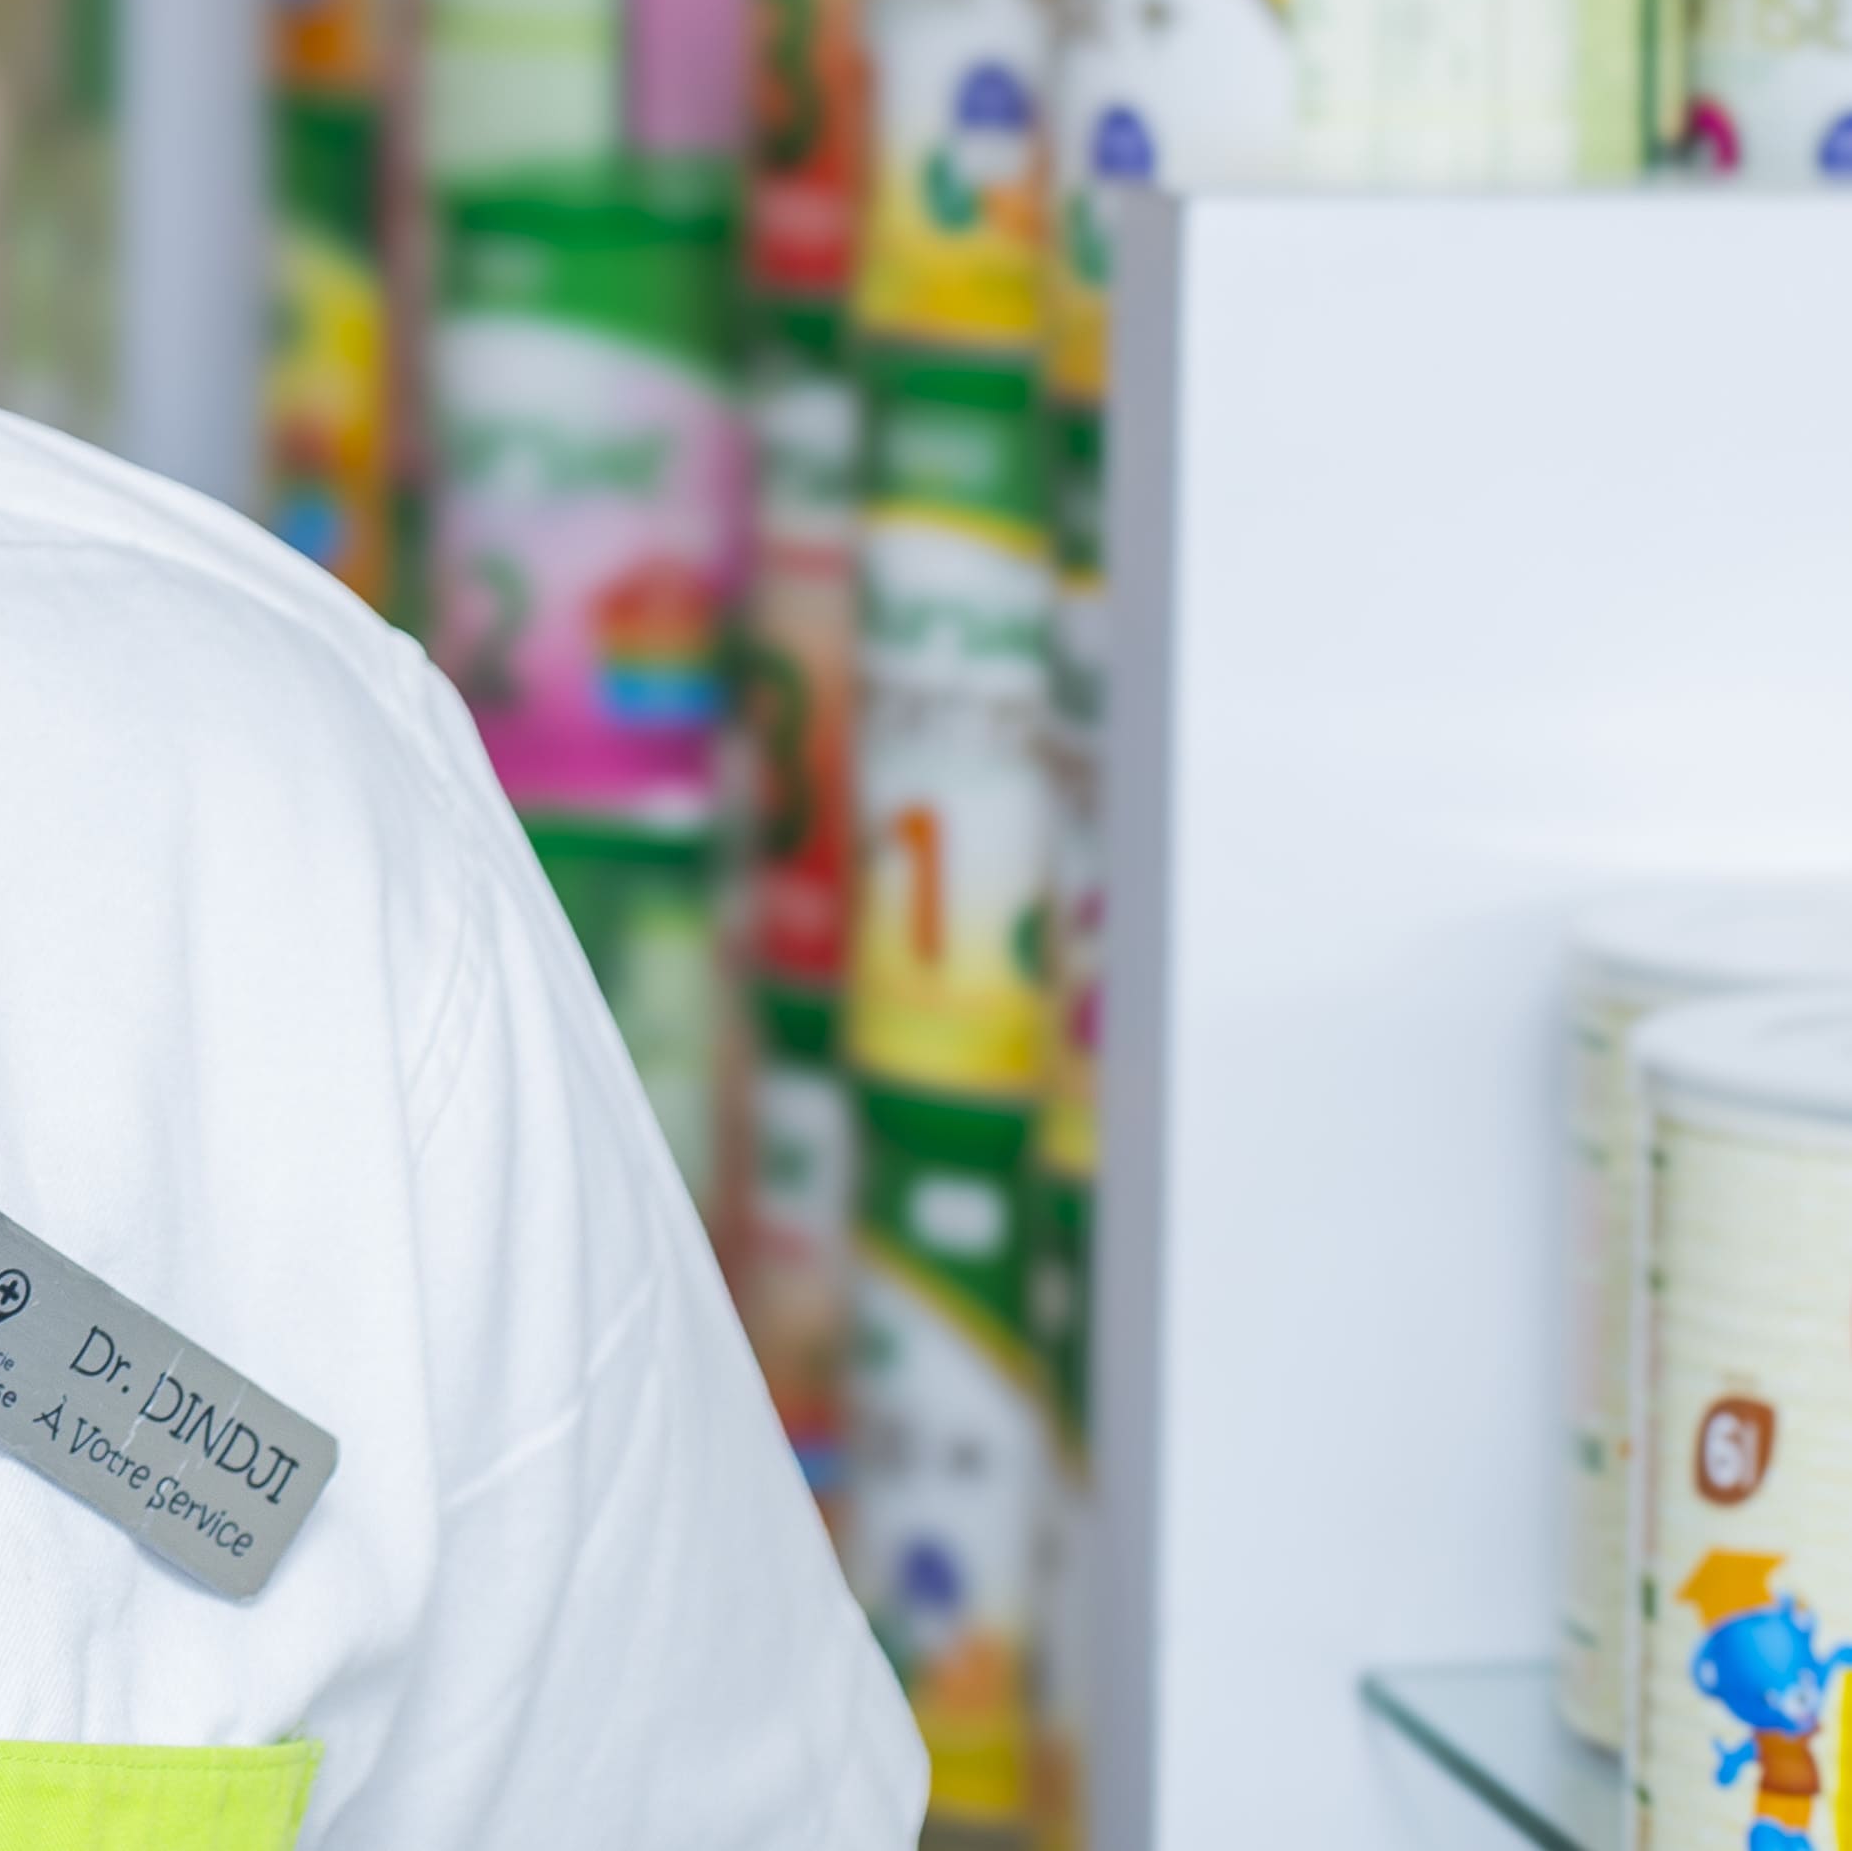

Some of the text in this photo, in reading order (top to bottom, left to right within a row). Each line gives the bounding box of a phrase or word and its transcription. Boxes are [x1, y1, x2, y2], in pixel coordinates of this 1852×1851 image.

[68, 1325, 301, 1505] Dr. DINDJI
[68, 1416, 151, 1490] Votre
[144, 1475, 255, 1558] Service
